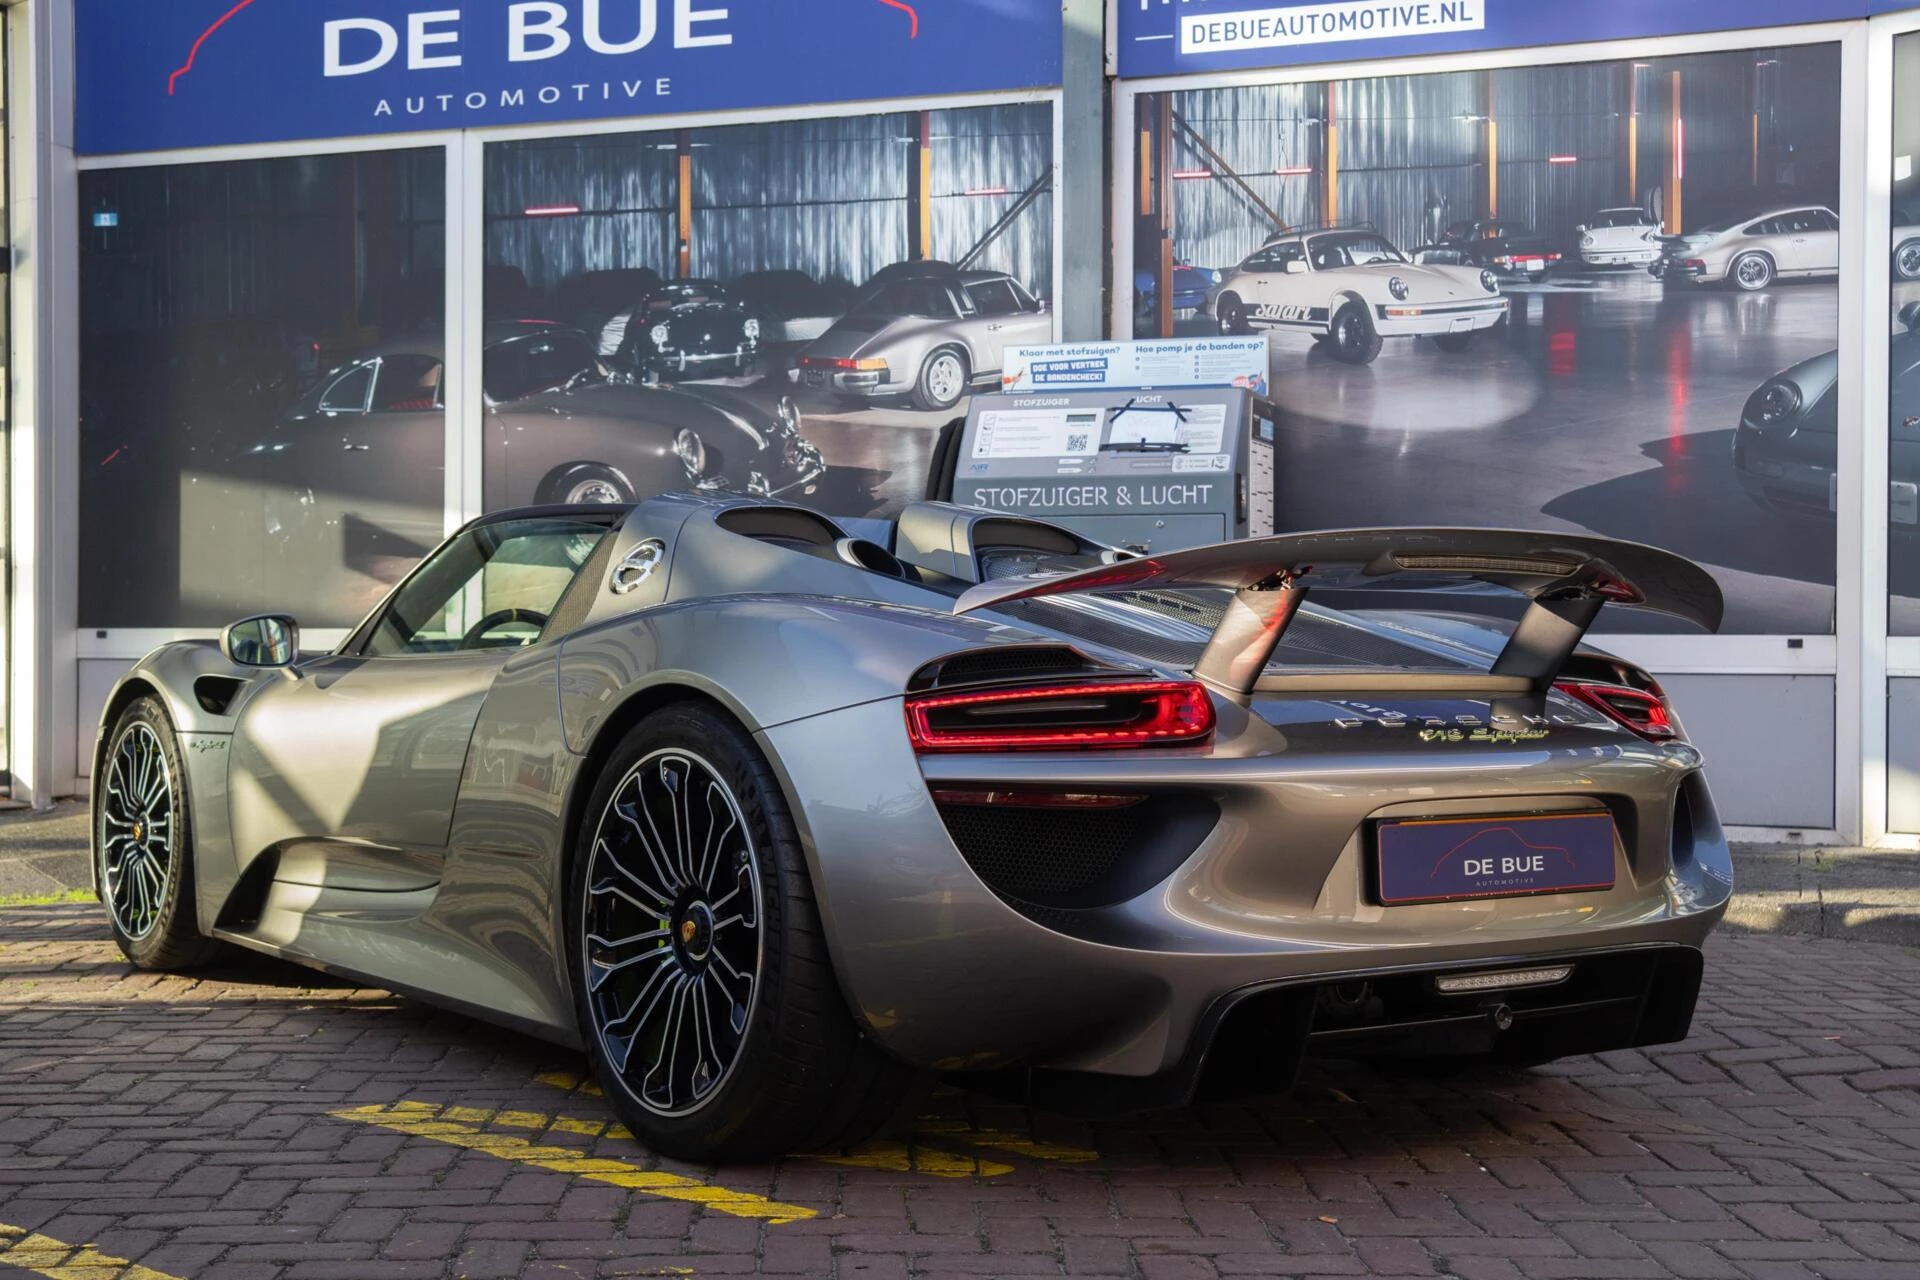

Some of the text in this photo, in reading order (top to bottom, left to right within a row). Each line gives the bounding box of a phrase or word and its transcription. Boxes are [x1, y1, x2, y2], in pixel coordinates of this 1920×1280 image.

[1192, 2, 1473, 44] DEBUEAUTOMOTIVE.NL
[323, 0, 733, 77] DE BUE
[374, 77, 672, 116] AUTOMOTIVE
[1019, 349, 1043, 357] Klaar
[1067, 346, 1121, 358] stofzuigen?
[1135, 341, 1264, 354] Hoe pomp je de banden op?
[1049, 362, 1069, 371] VOOR
[1070, 360, 1106, 370] VERTREK
[1012, 398, 1070, 407] STOFZUIGER
[974, 484, 1213, 507] STOFZUIGER & LUCHT
[1464, 855, 1544, 876] DE BUE
[1475, 877, 1535, 887] AUTOMOTIVE
